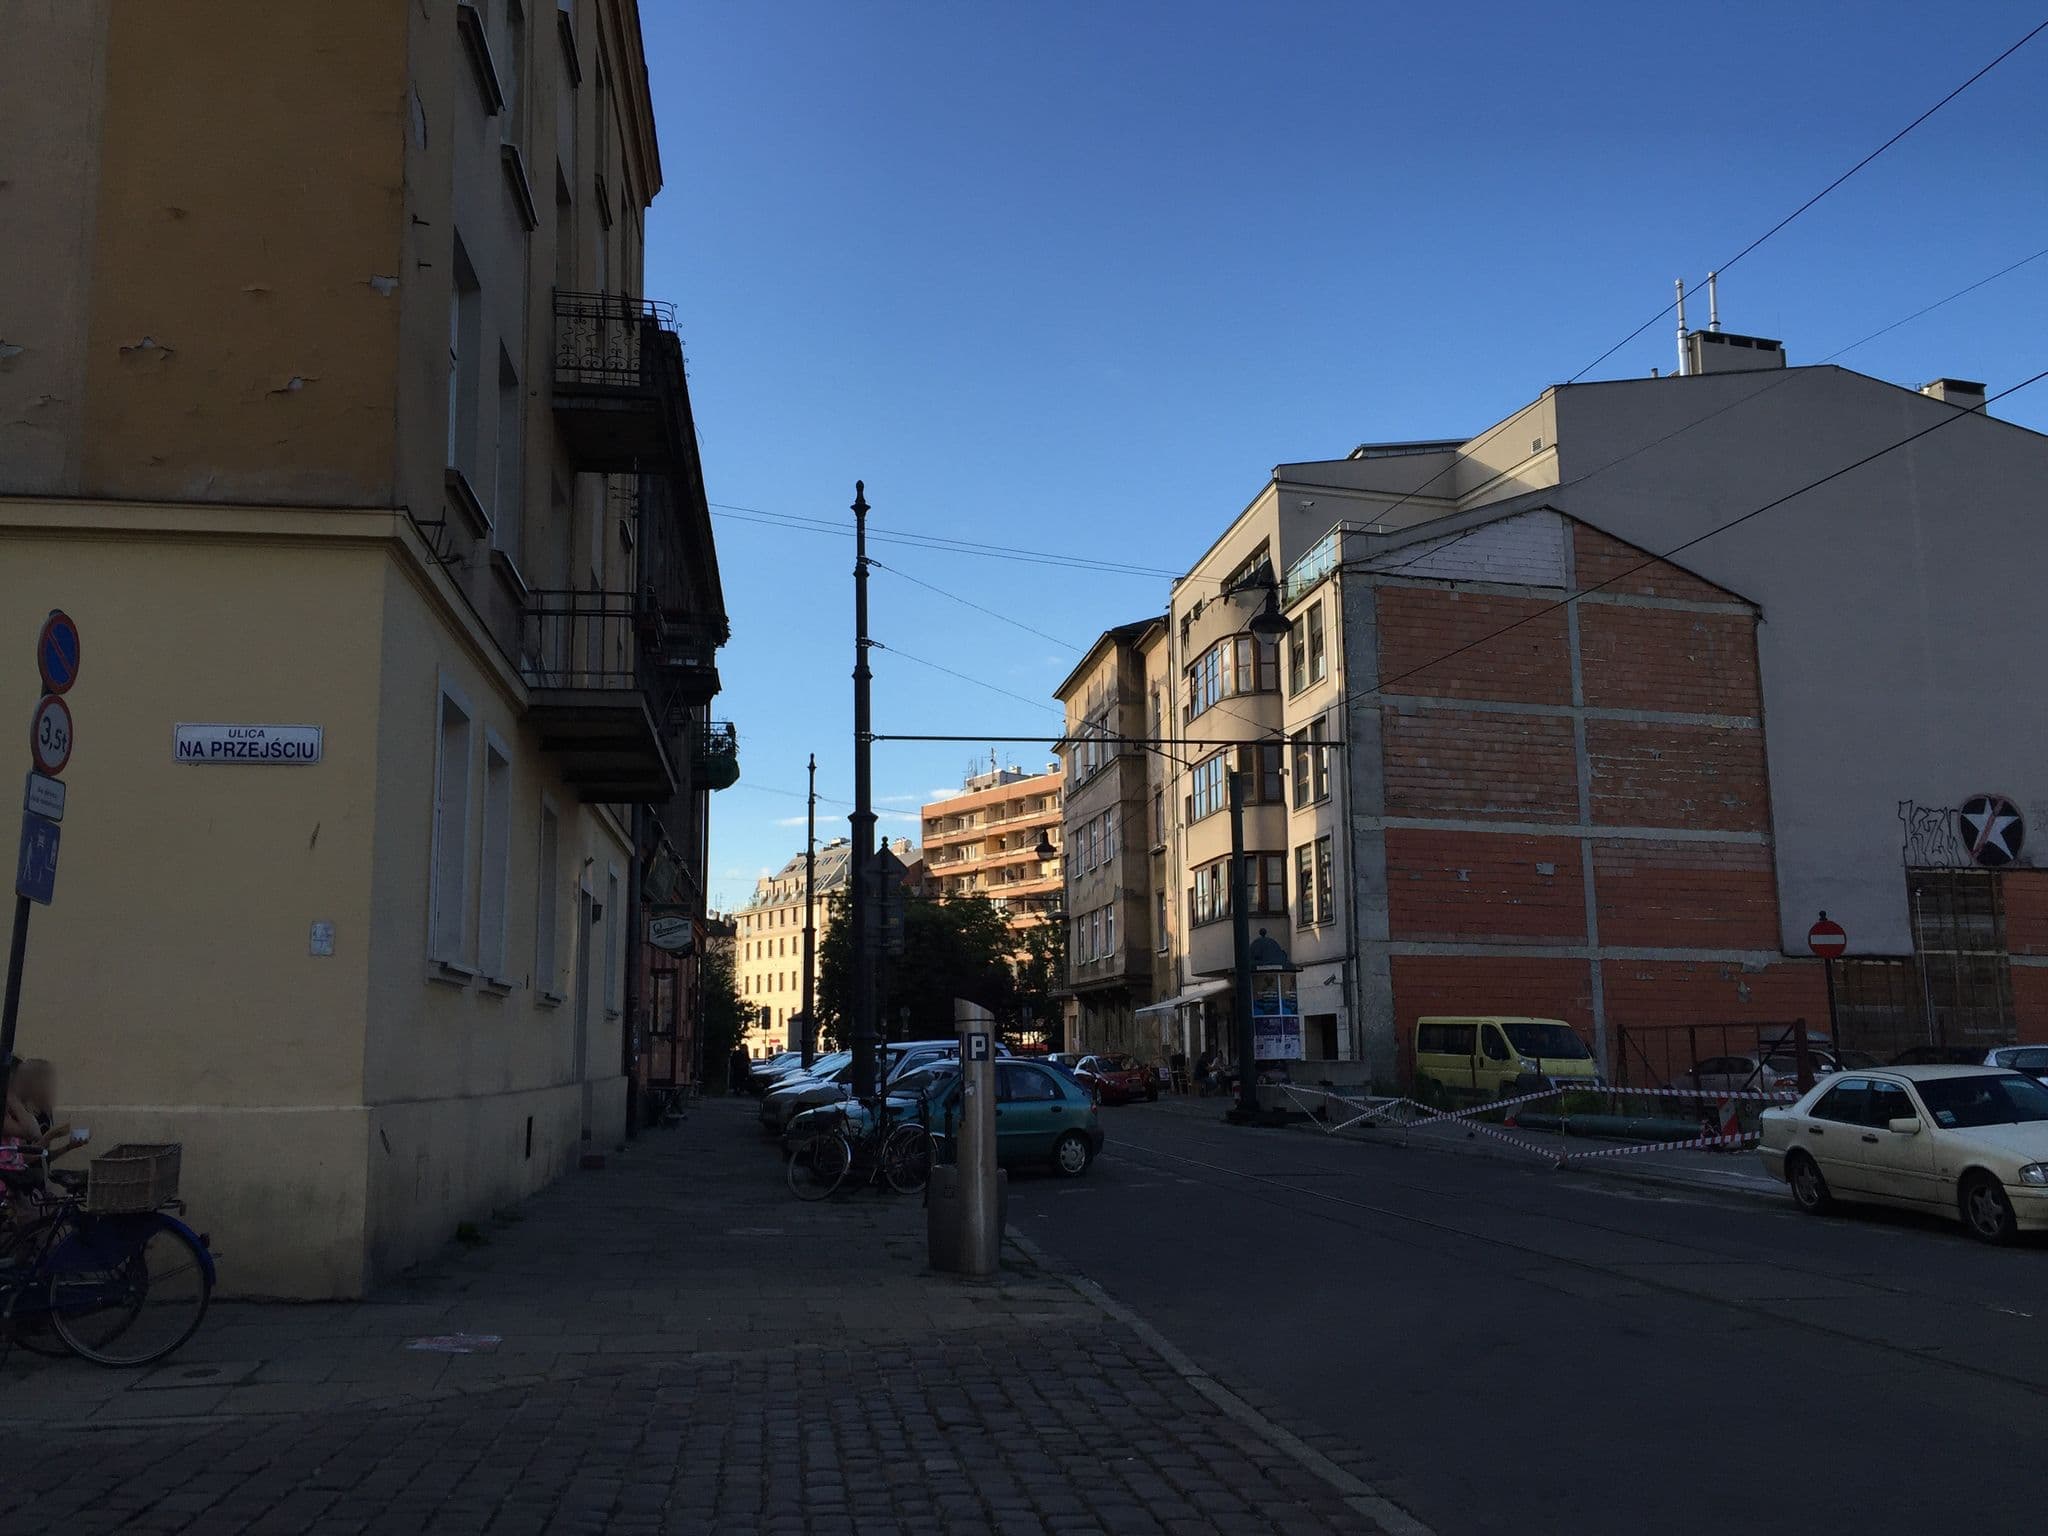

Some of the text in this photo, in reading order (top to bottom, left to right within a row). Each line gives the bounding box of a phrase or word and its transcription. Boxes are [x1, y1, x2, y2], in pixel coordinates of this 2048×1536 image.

[228, 729, 265, 739] ULICA
[179, 738, 314, 759] NA PRZEJŚCIU
[971, 1035, 986, 1059] P
